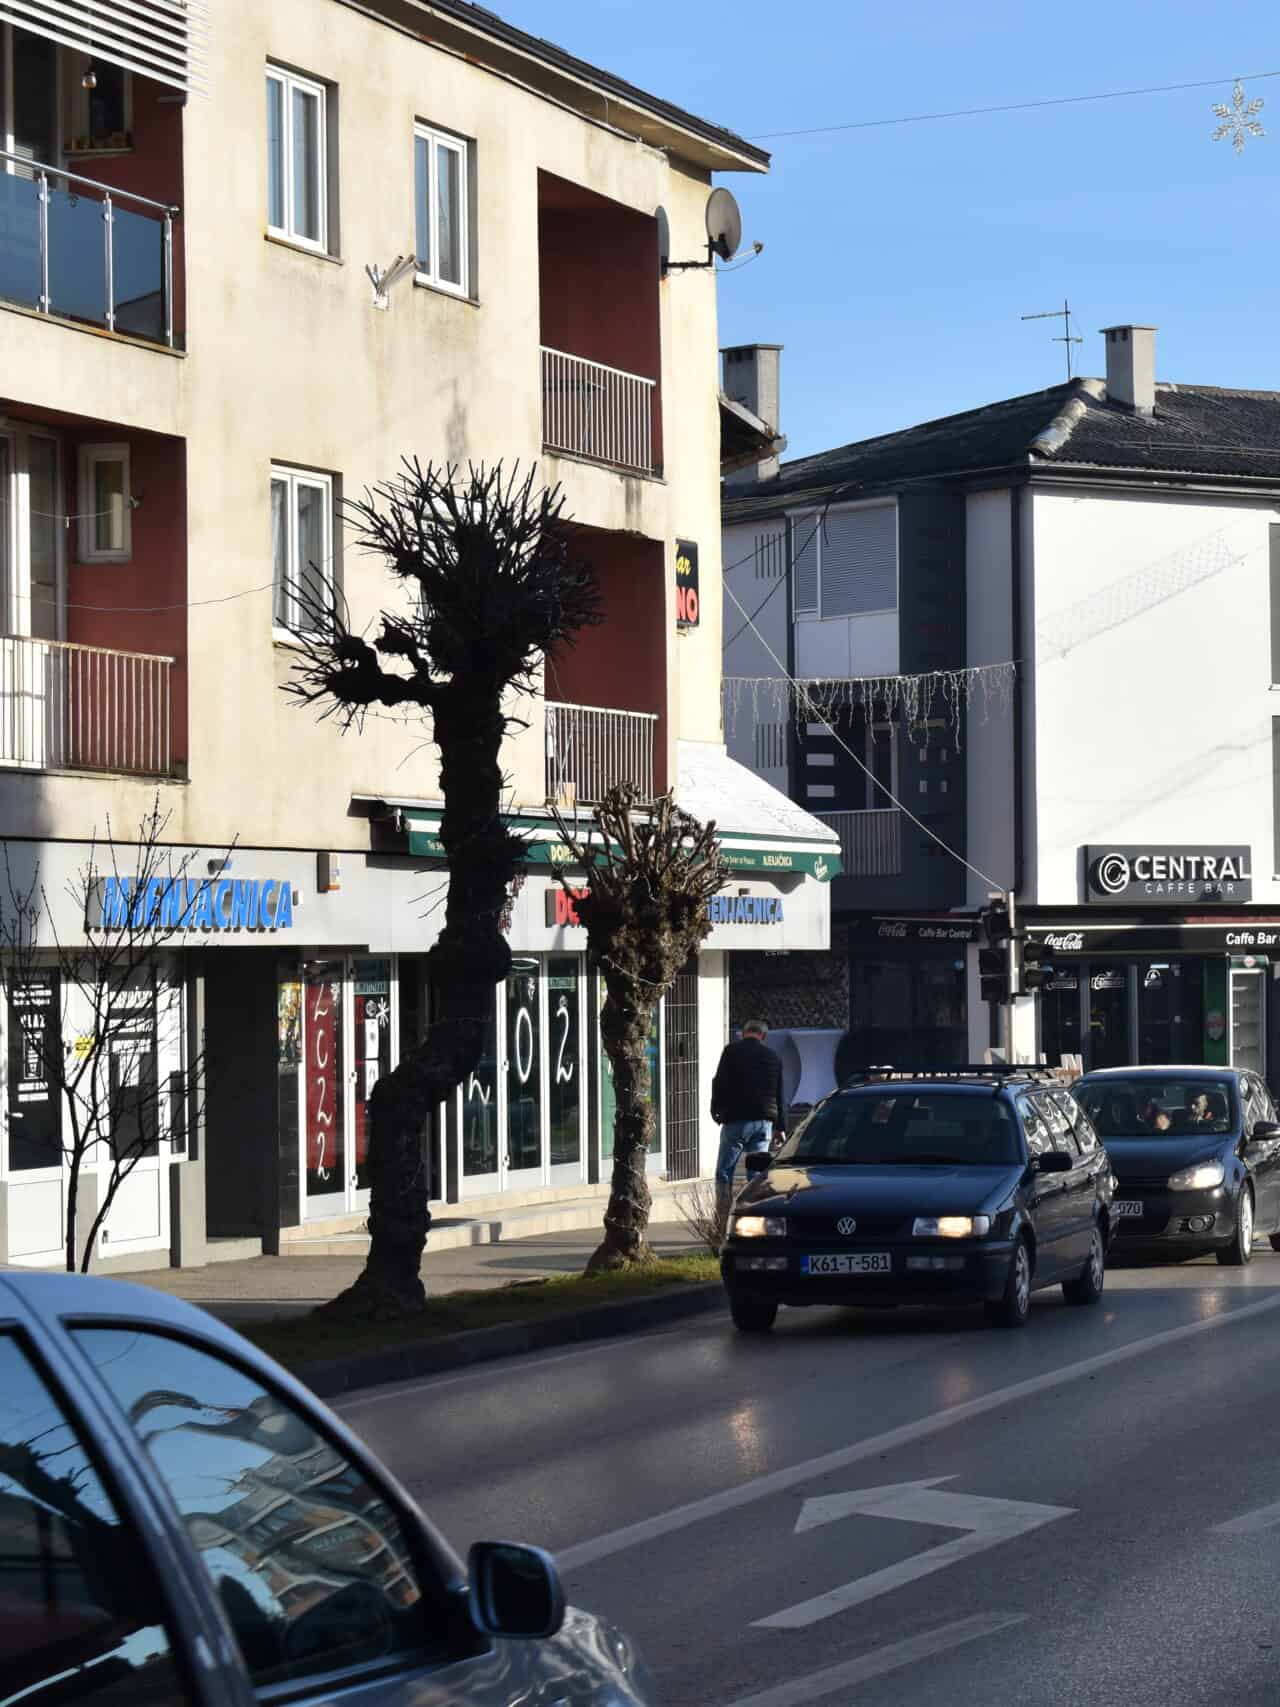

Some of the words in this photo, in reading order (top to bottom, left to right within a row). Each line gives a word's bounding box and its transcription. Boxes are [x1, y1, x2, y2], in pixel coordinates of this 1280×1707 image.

[1135, 856, 1250, 880] CENTRAL
[1144, 883, 1196, 894] CAFFE
[1205, 883, 1234, 894] BAR
[1226, 932, 1254, 944] Caffe
[1257, 932, 1277, 944] Bar
[810, 1255, 889, 1272] K61-T-581
